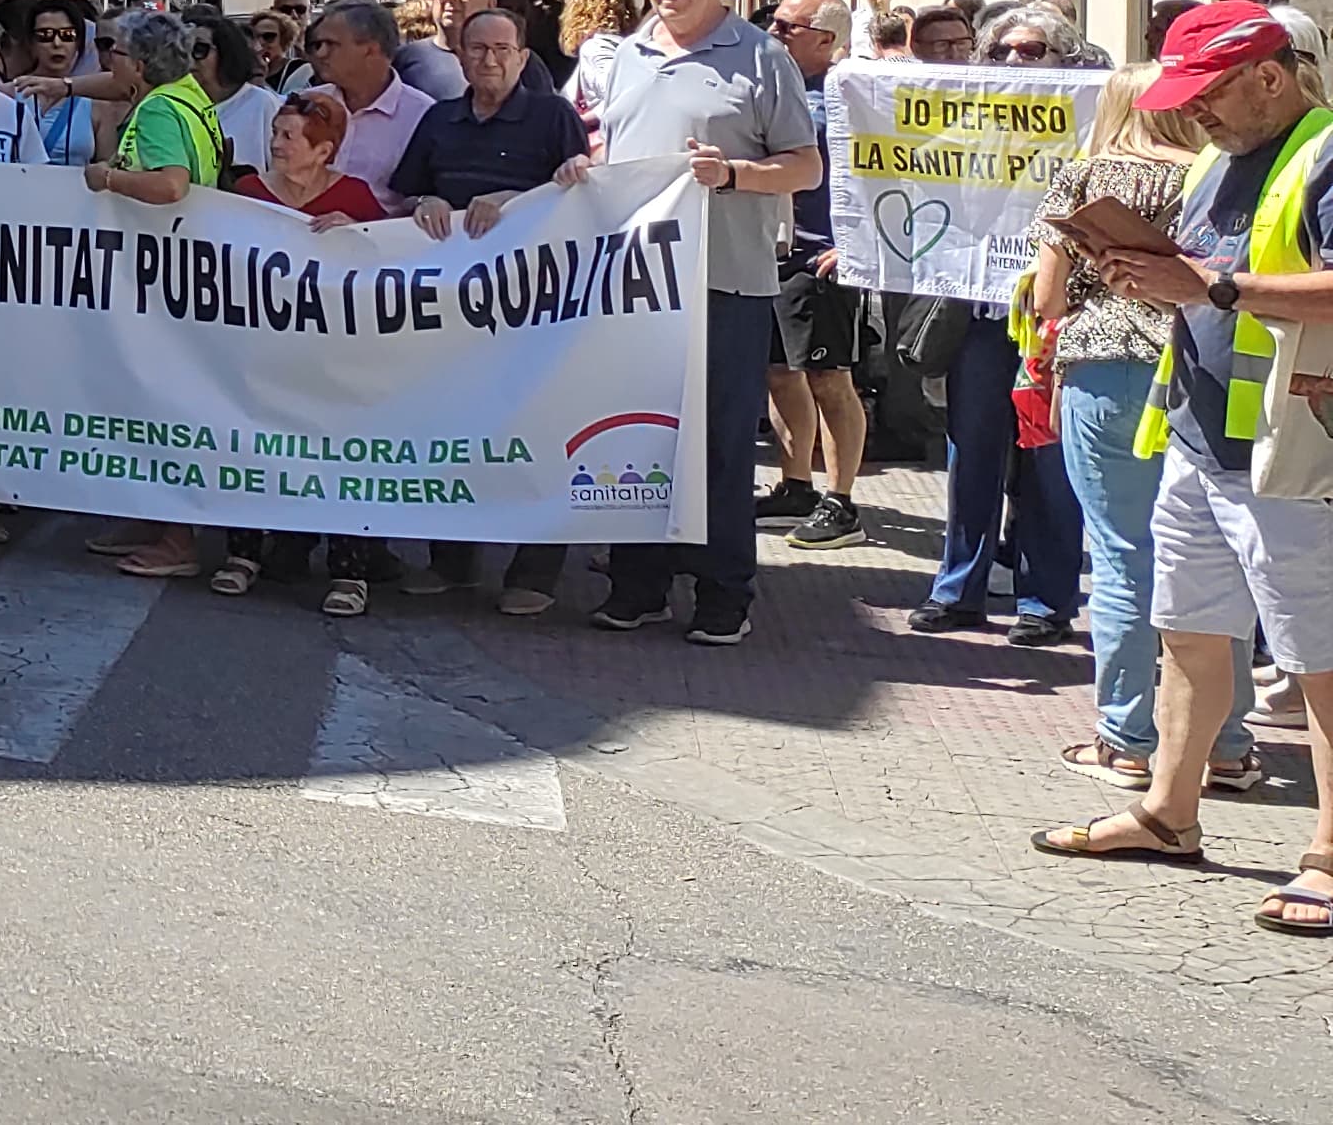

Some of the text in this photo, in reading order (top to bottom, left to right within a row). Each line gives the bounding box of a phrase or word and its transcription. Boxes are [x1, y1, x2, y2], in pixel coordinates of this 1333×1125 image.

[902, 98, 1067, 133] JO DEFENSO
[853, 142, 1073, 185] LA SANITAT PÚB
[989, 235, 1039, 258] AMNIS
[137, 217, 329, 335] PÚBLICA
[342, 269, 358, 335] I
[375, 267, 443, 335] DE
[458, 219, 681, 336] QUALITAT
[64, 413, 217, 452] DEFENSA
[231, 429, 239, 452] I
[254, 432, 417, 464] MILLORA
[429, 438, 470, 463] DE
[483, 437, 533, 463] LA
[59, 447, 206, 489] PÚBLICA
[219, 465, 265, 494] DE
[279, 471, 325, 500] LA
[339, 477, 475, 504] RIBERA
[571, 482, 673, 504] sanitatpú
